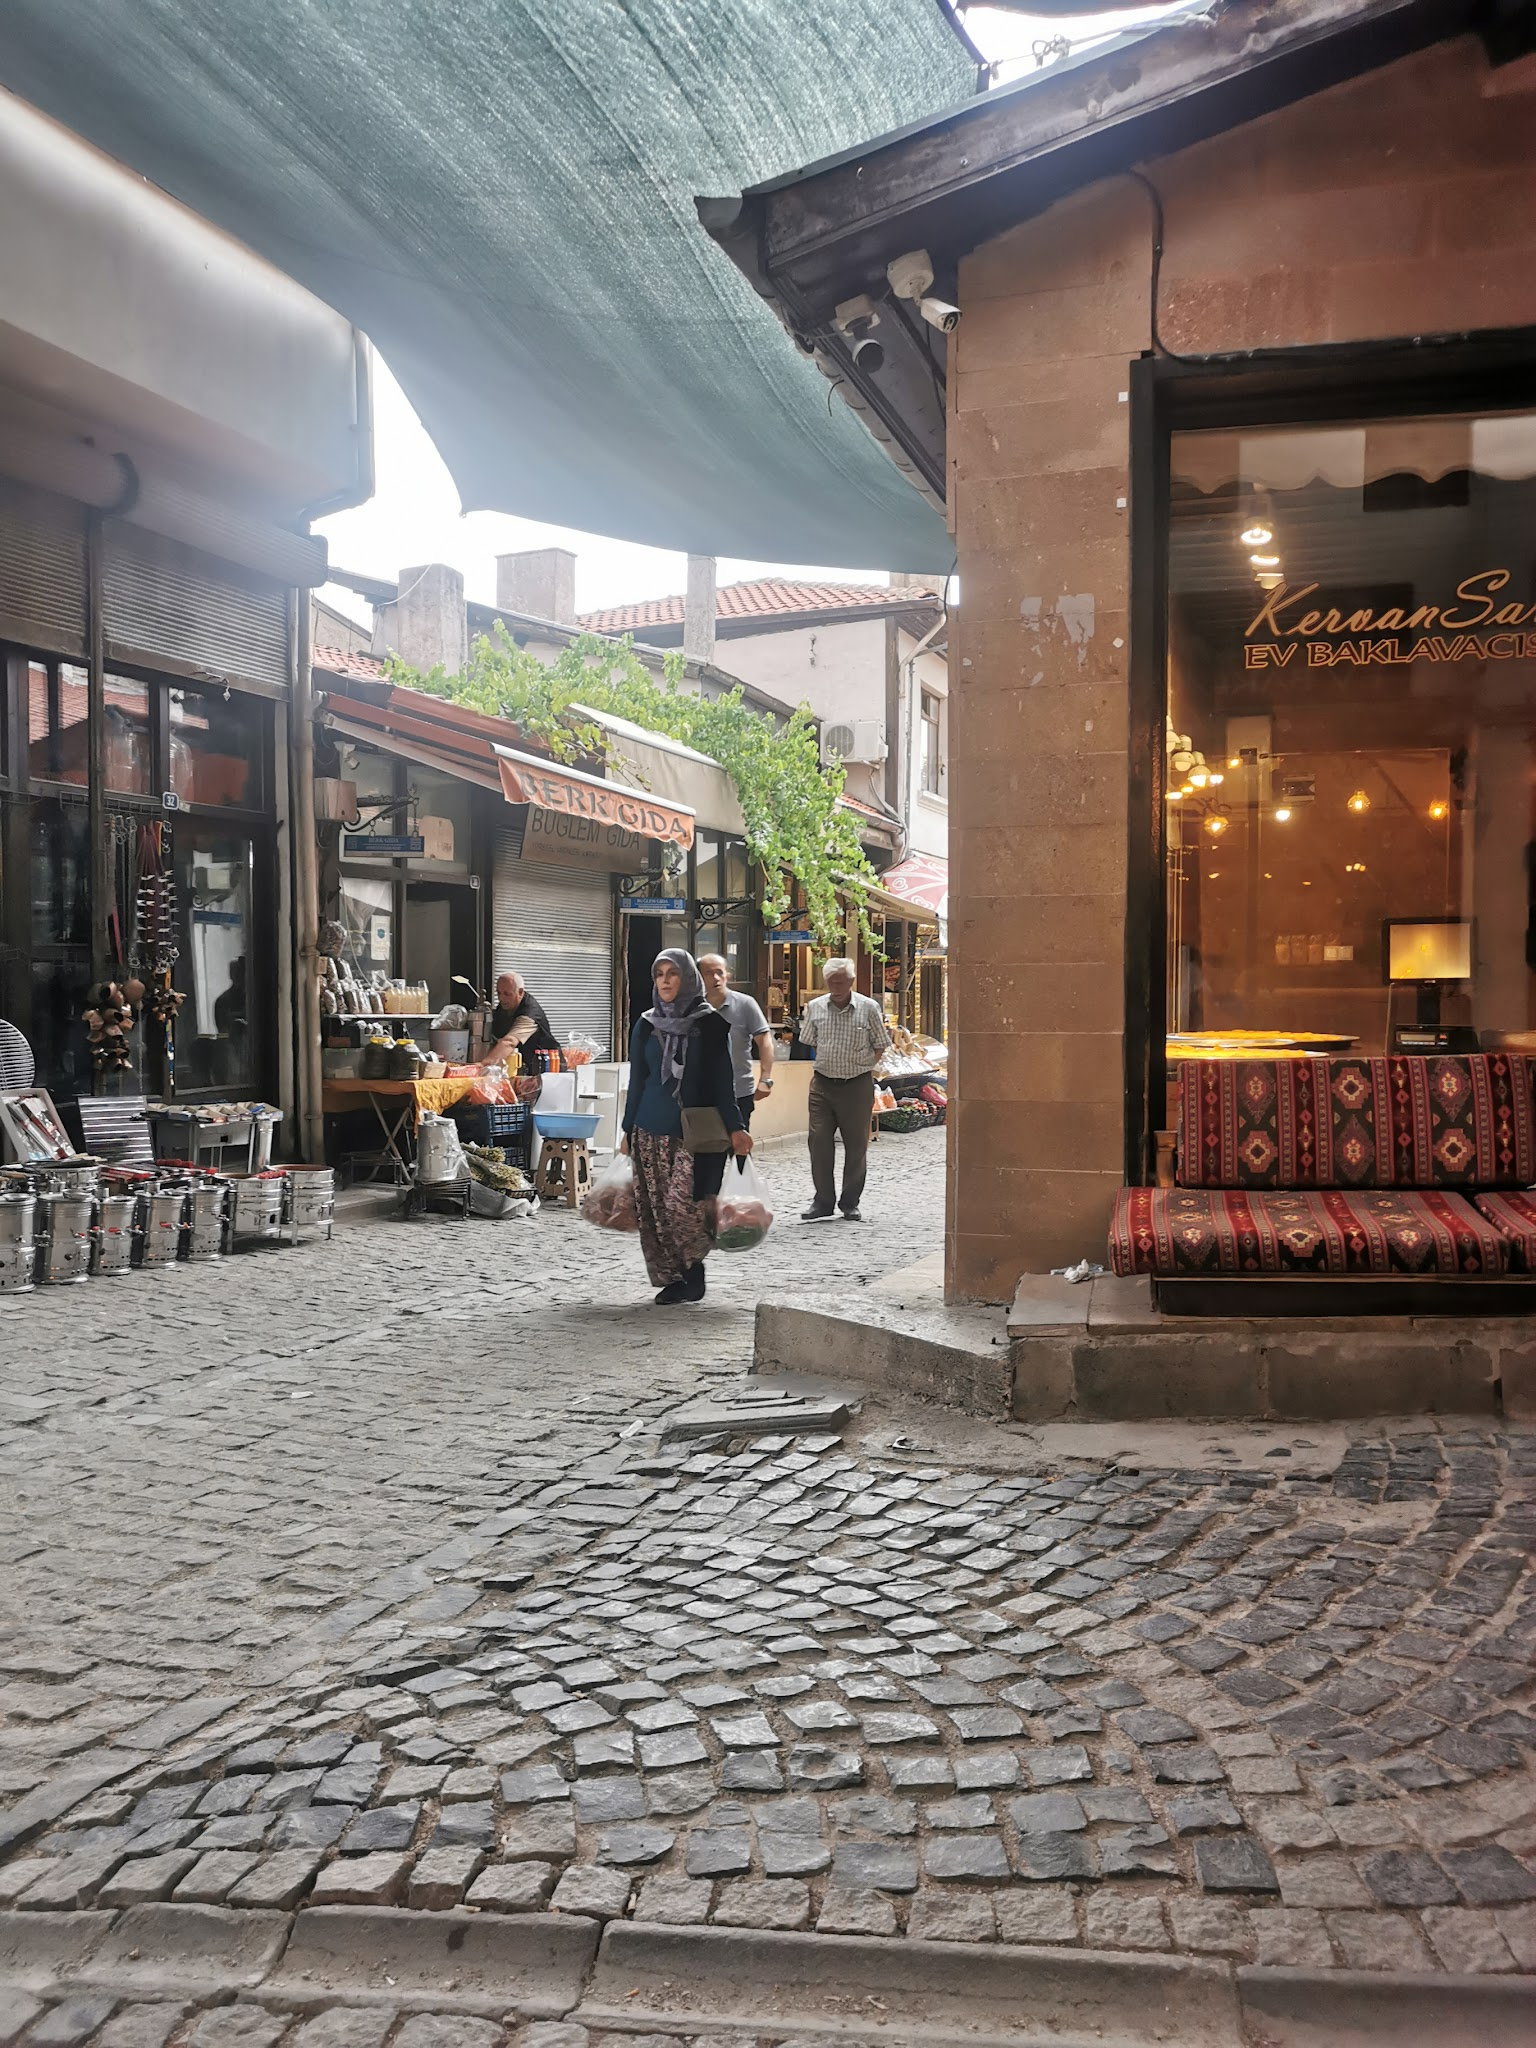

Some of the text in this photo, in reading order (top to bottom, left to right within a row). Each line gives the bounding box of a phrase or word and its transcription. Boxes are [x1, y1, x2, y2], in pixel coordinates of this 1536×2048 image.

[1245, 569, 1536, 637] KervanSa
[1244, 643, 1298, 669] EV
[166, 795, 175, 807] 32
[518, 772, 688, 838] BERK GIDA
[606, 825, 640, 850] GIDA
